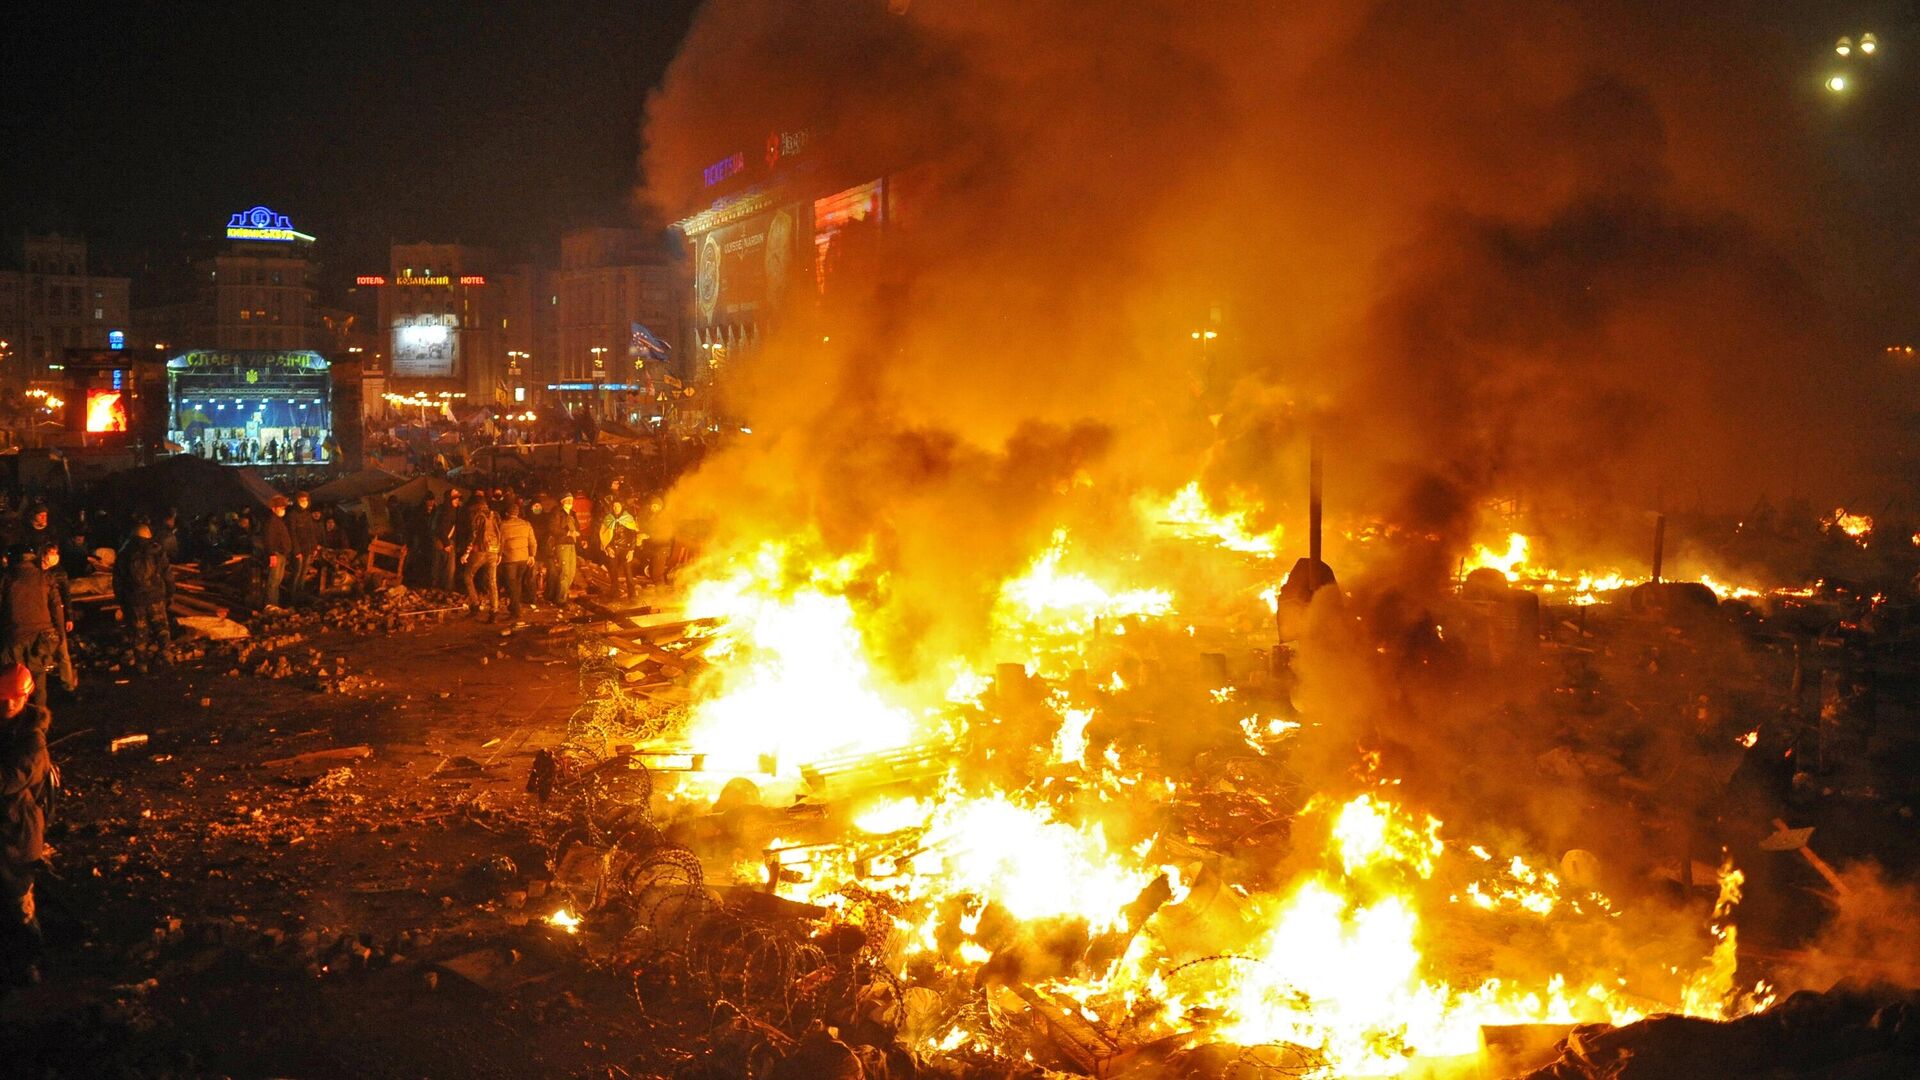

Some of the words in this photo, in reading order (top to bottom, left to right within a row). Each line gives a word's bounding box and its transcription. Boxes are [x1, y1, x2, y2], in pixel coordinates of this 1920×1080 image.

[356, 276, 385, 285] ГОТЕЛЬ
[396, 276, 449, 286] КОЗАЦЬКИЙ
[460, 276, 485, 285] HOTEL
[187, 352, 240, 366] СЛАВА
